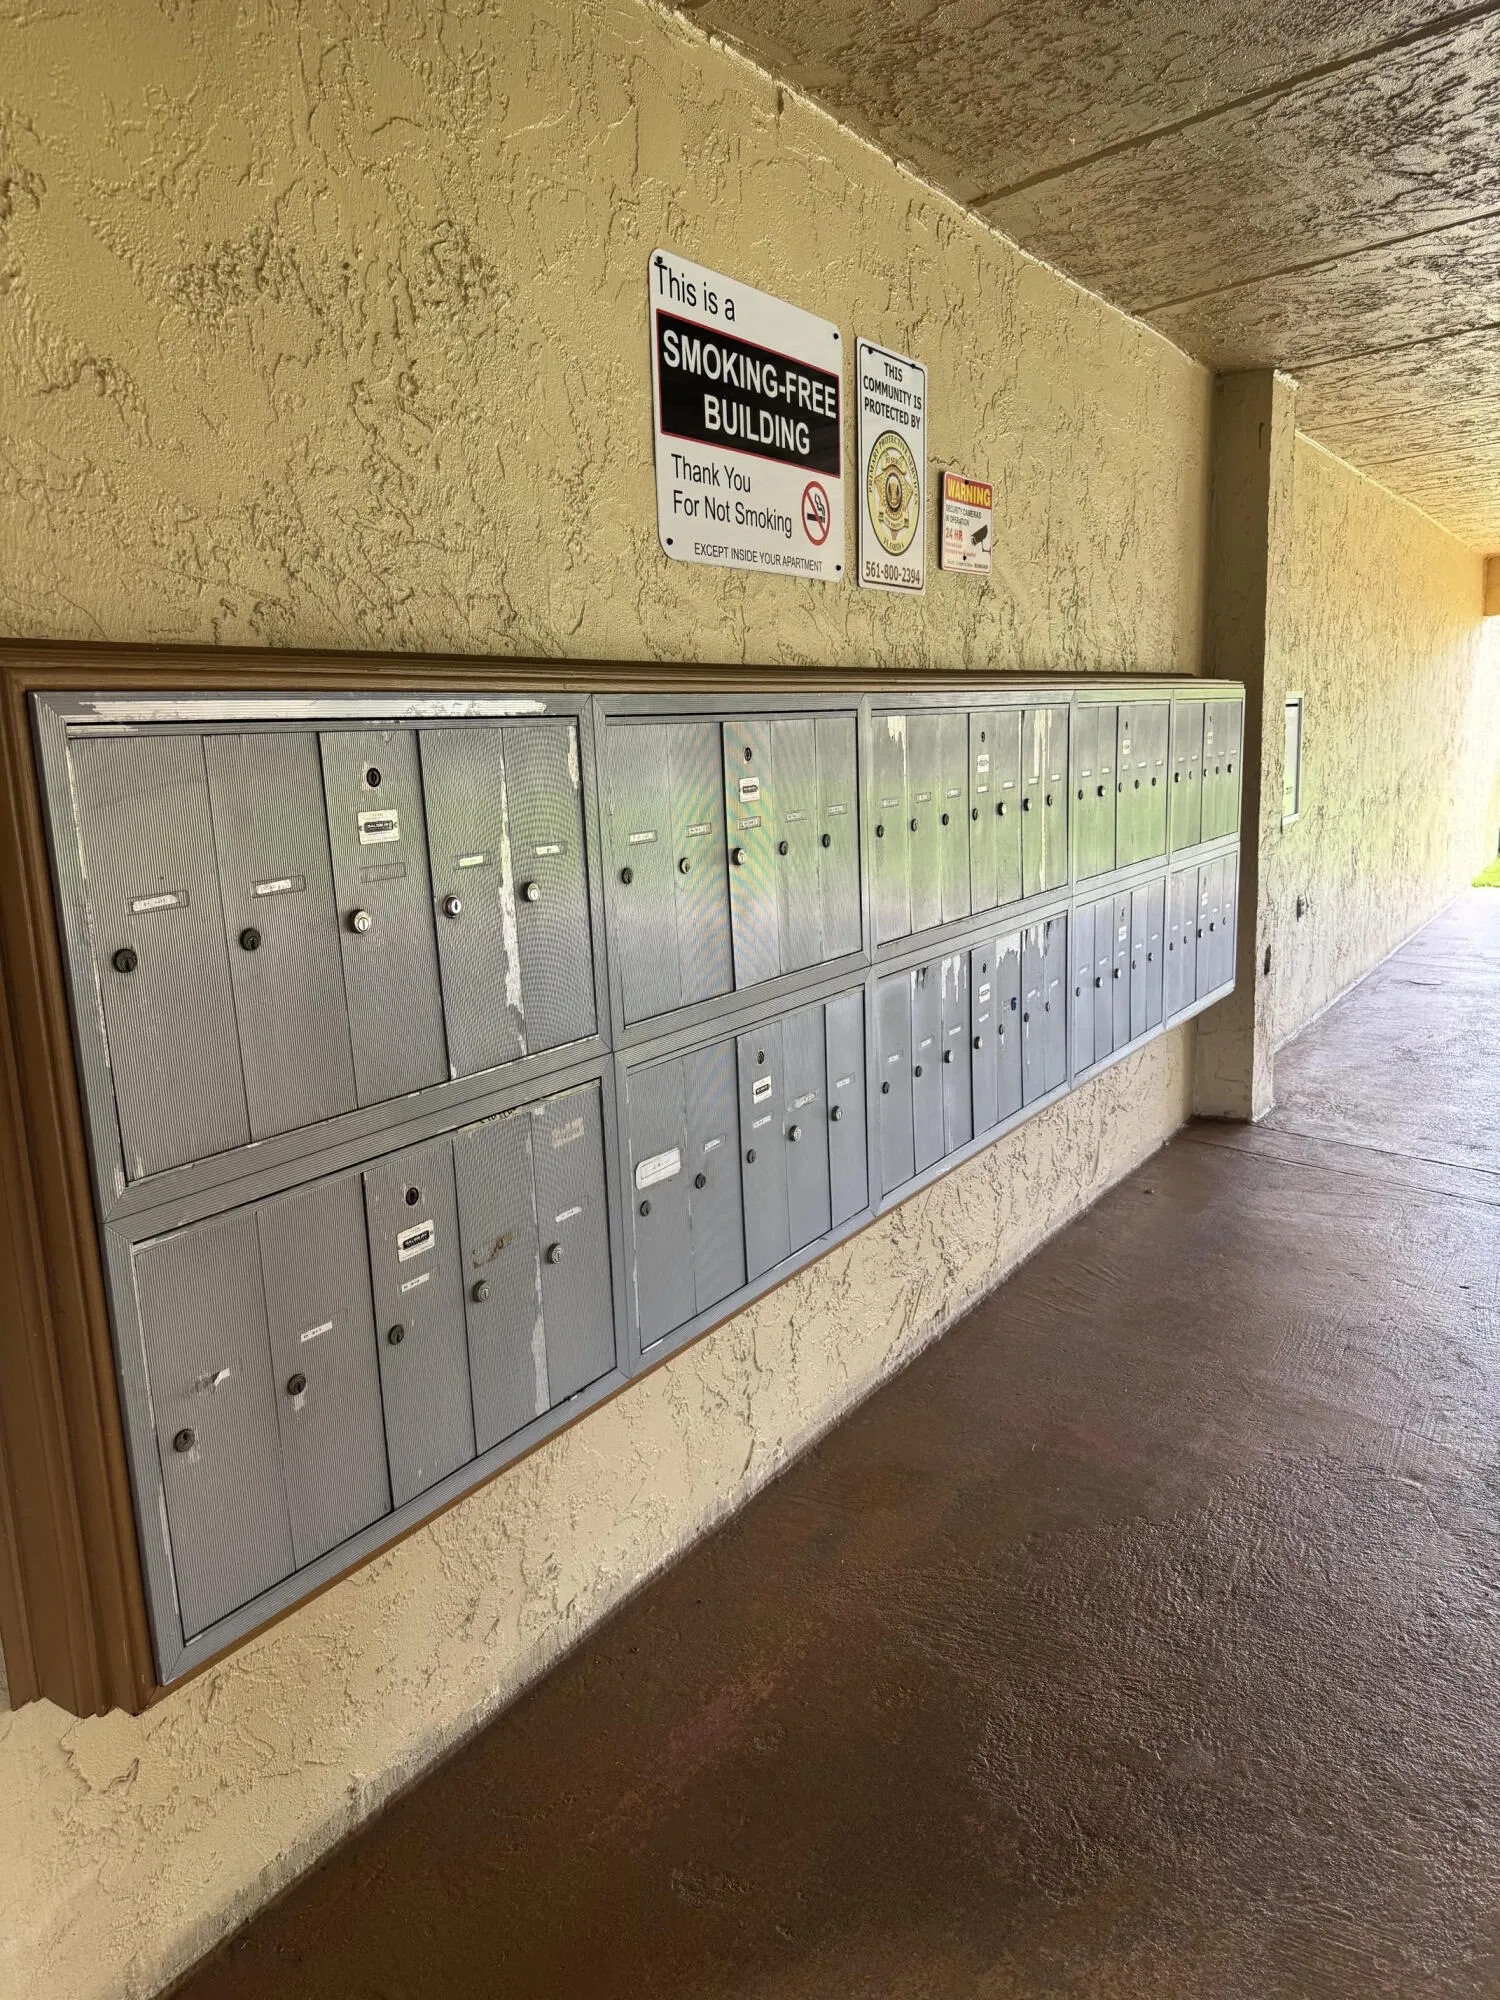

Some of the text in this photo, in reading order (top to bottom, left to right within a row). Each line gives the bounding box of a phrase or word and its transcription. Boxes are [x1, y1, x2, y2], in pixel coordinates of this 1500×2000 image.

[654, 261, 736, 322] This is a
[663, 329, 837, 419] SMOKING-FREE
[883, 362, 903, 382] THIS
[863, 375, 922, 410] COMMUNITY IS
[703, 393, 810, 455] BUILDING
[864, 396, 921, 430] PROTECTED BY
[671, 453, 751, 493] Thank You
[947, 478, 991, 507] WARNING
[673, 490, 793, 539] For Not Smoking
[963, 508, 982, 519] CAMERAS
[945, 527, 963, 541] 24 HR
[694, 542, 823, 572] EXCEPT INSIDE YOUR APARTMENT
[865, 560, 921, 584] 561-800-2394
